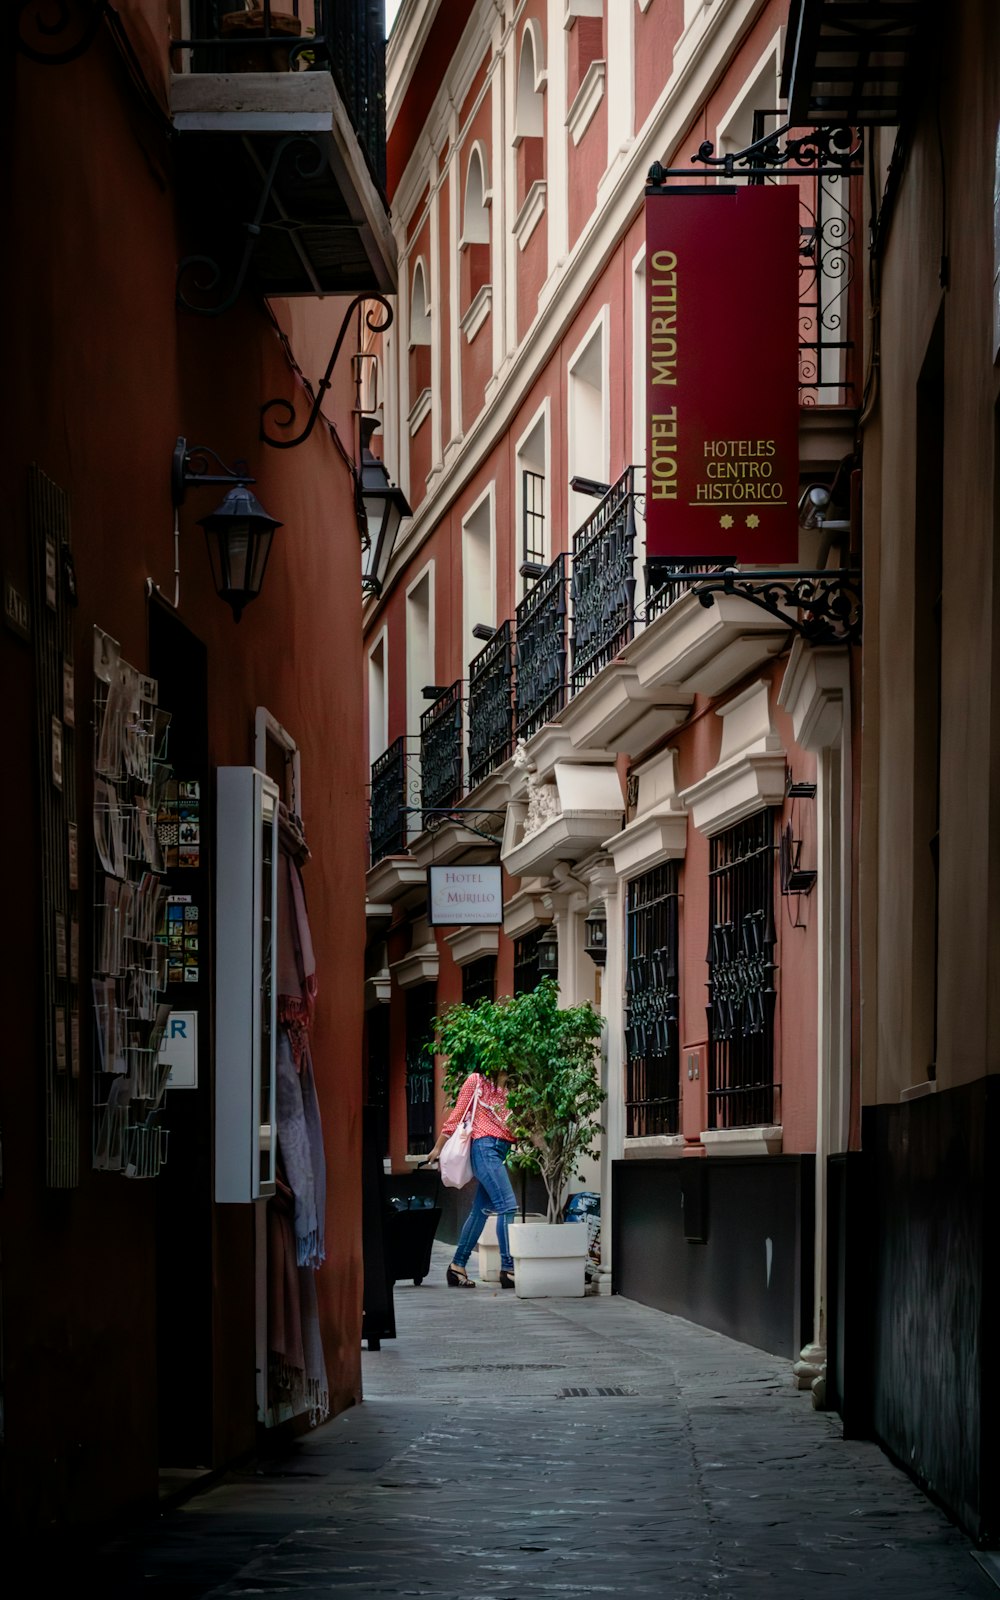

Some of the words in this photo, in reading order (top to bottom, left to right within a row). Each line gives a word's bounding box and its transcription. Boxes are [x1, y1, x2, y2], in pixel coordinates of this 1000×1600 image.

[651, 249, 678, 386] MURILLO
[651, 406, 678, 500] HOTEL
[703, 440, 776, 457] HOTELES
[706, 461, 773, 479] CENTRO
[696, 479, 783, 500] HISTÓRICO
[445, 873, 484, 883] HOTEL
[447, 892, 495, 903] MURILLO
